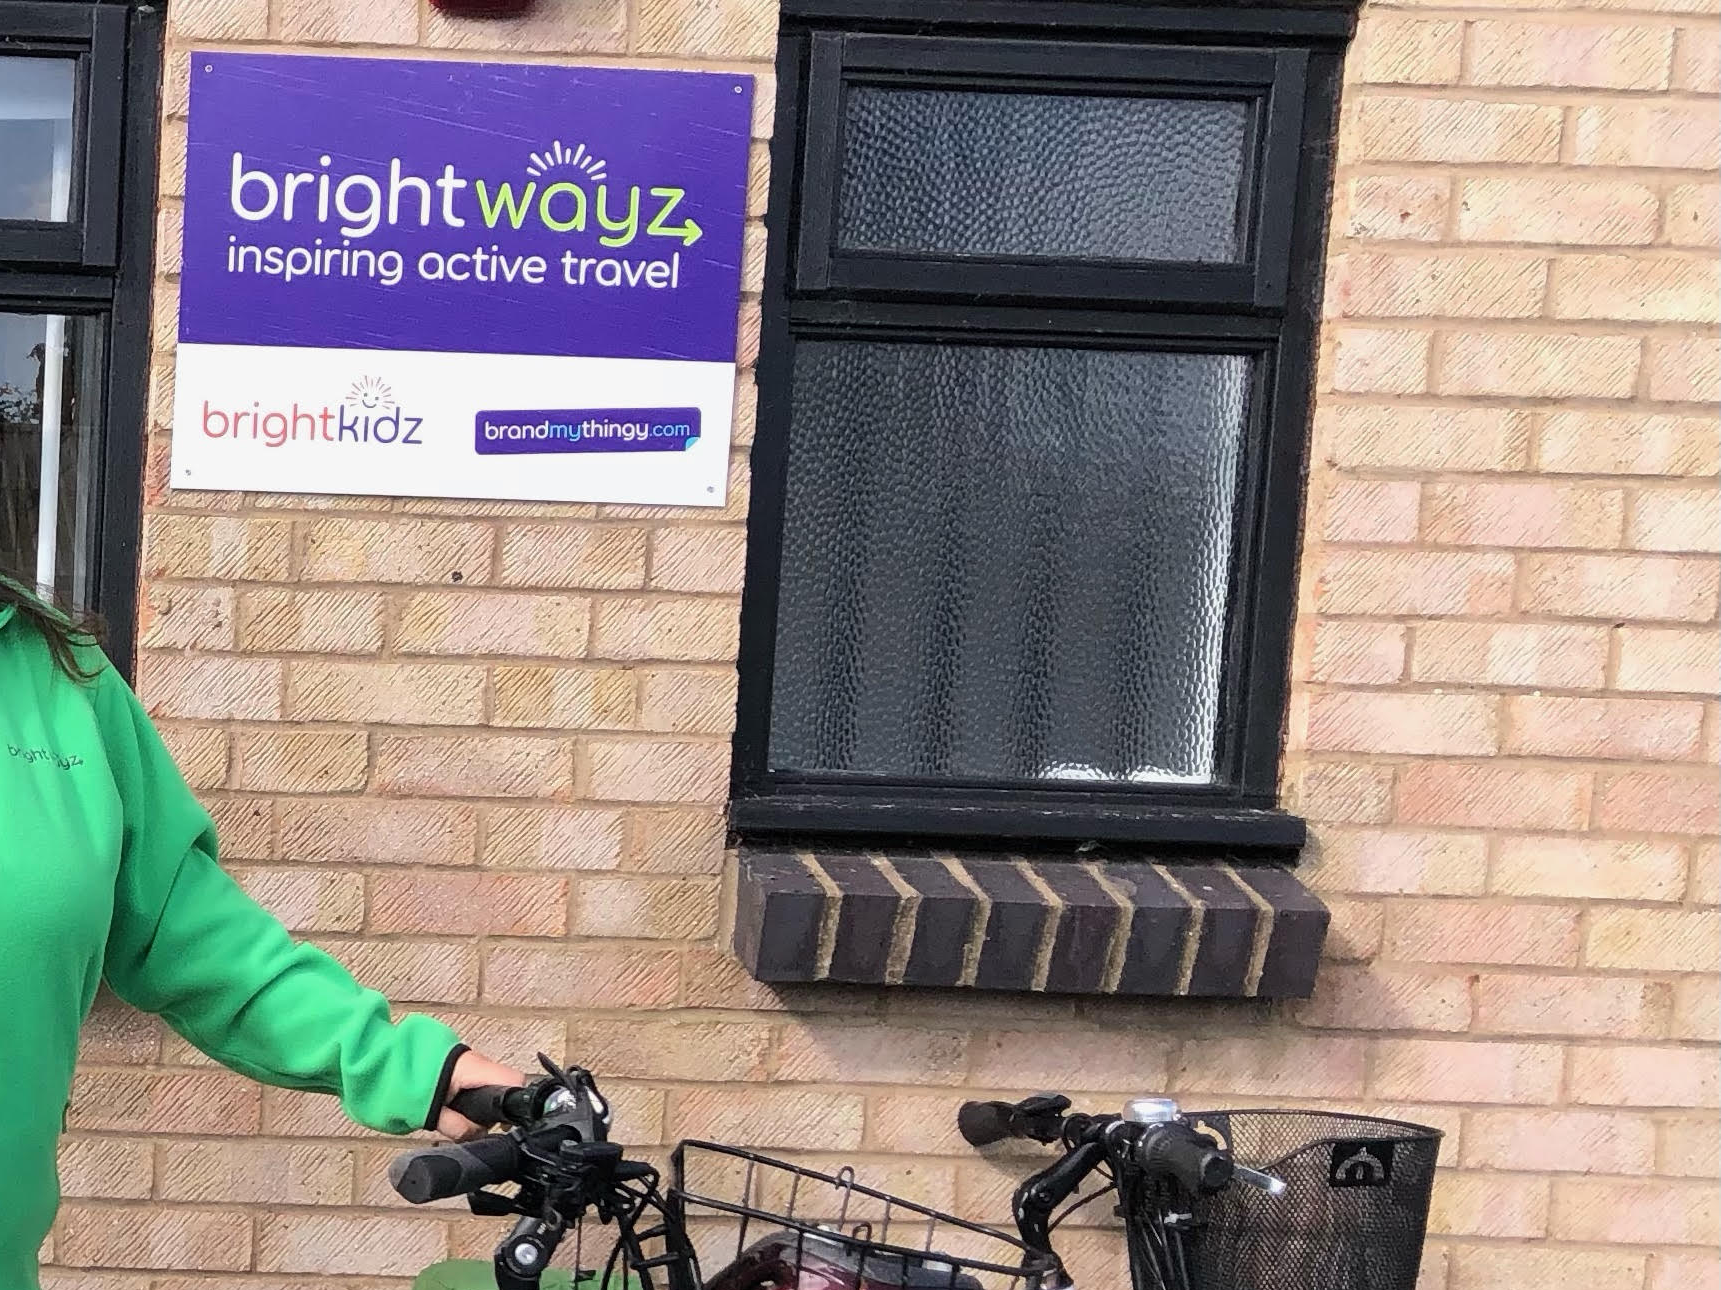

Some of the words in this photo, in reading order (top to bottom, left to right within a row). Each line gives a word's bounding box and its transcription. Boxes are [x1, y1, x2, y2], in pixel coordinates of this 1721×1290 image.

[230, 152, 703, 247] brightwayz
[227, 235, 403, 286] inspiring
[417, 246, 547, 285] active
[562, 250, 680, 289] travel
[202, 400, 424, 447] brightkidz
[484, 418, 691, 442] brandmythingy.com
